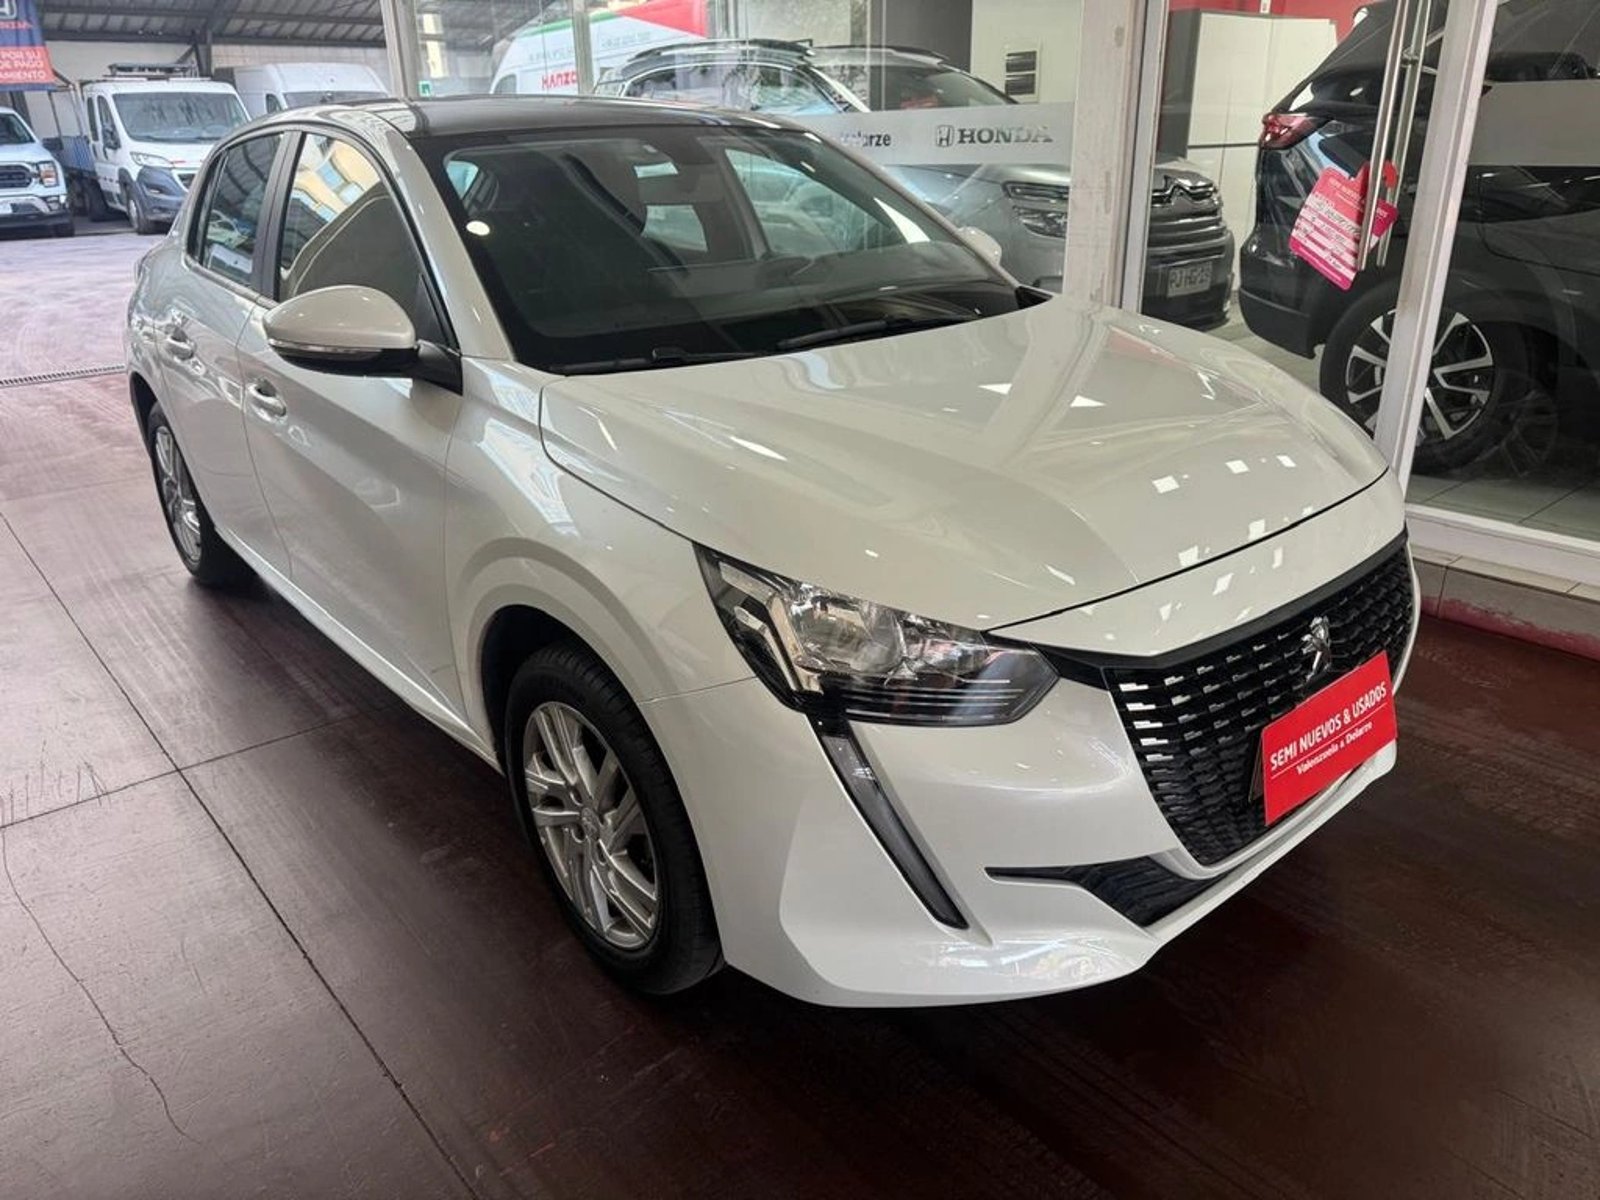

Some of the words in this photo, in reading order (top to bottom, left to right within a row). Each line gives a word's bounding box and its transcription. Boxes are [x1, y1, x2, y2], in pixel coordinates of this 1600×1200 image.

[957, 126, 1053, 145] HONDA
[1270, 741, 1298, 771] SEMI
[1299, 714, 1342, 753] NUEVOS
[1343, 708, 1351, 724] &
[1351, 681, 1387, 718] USADOS
